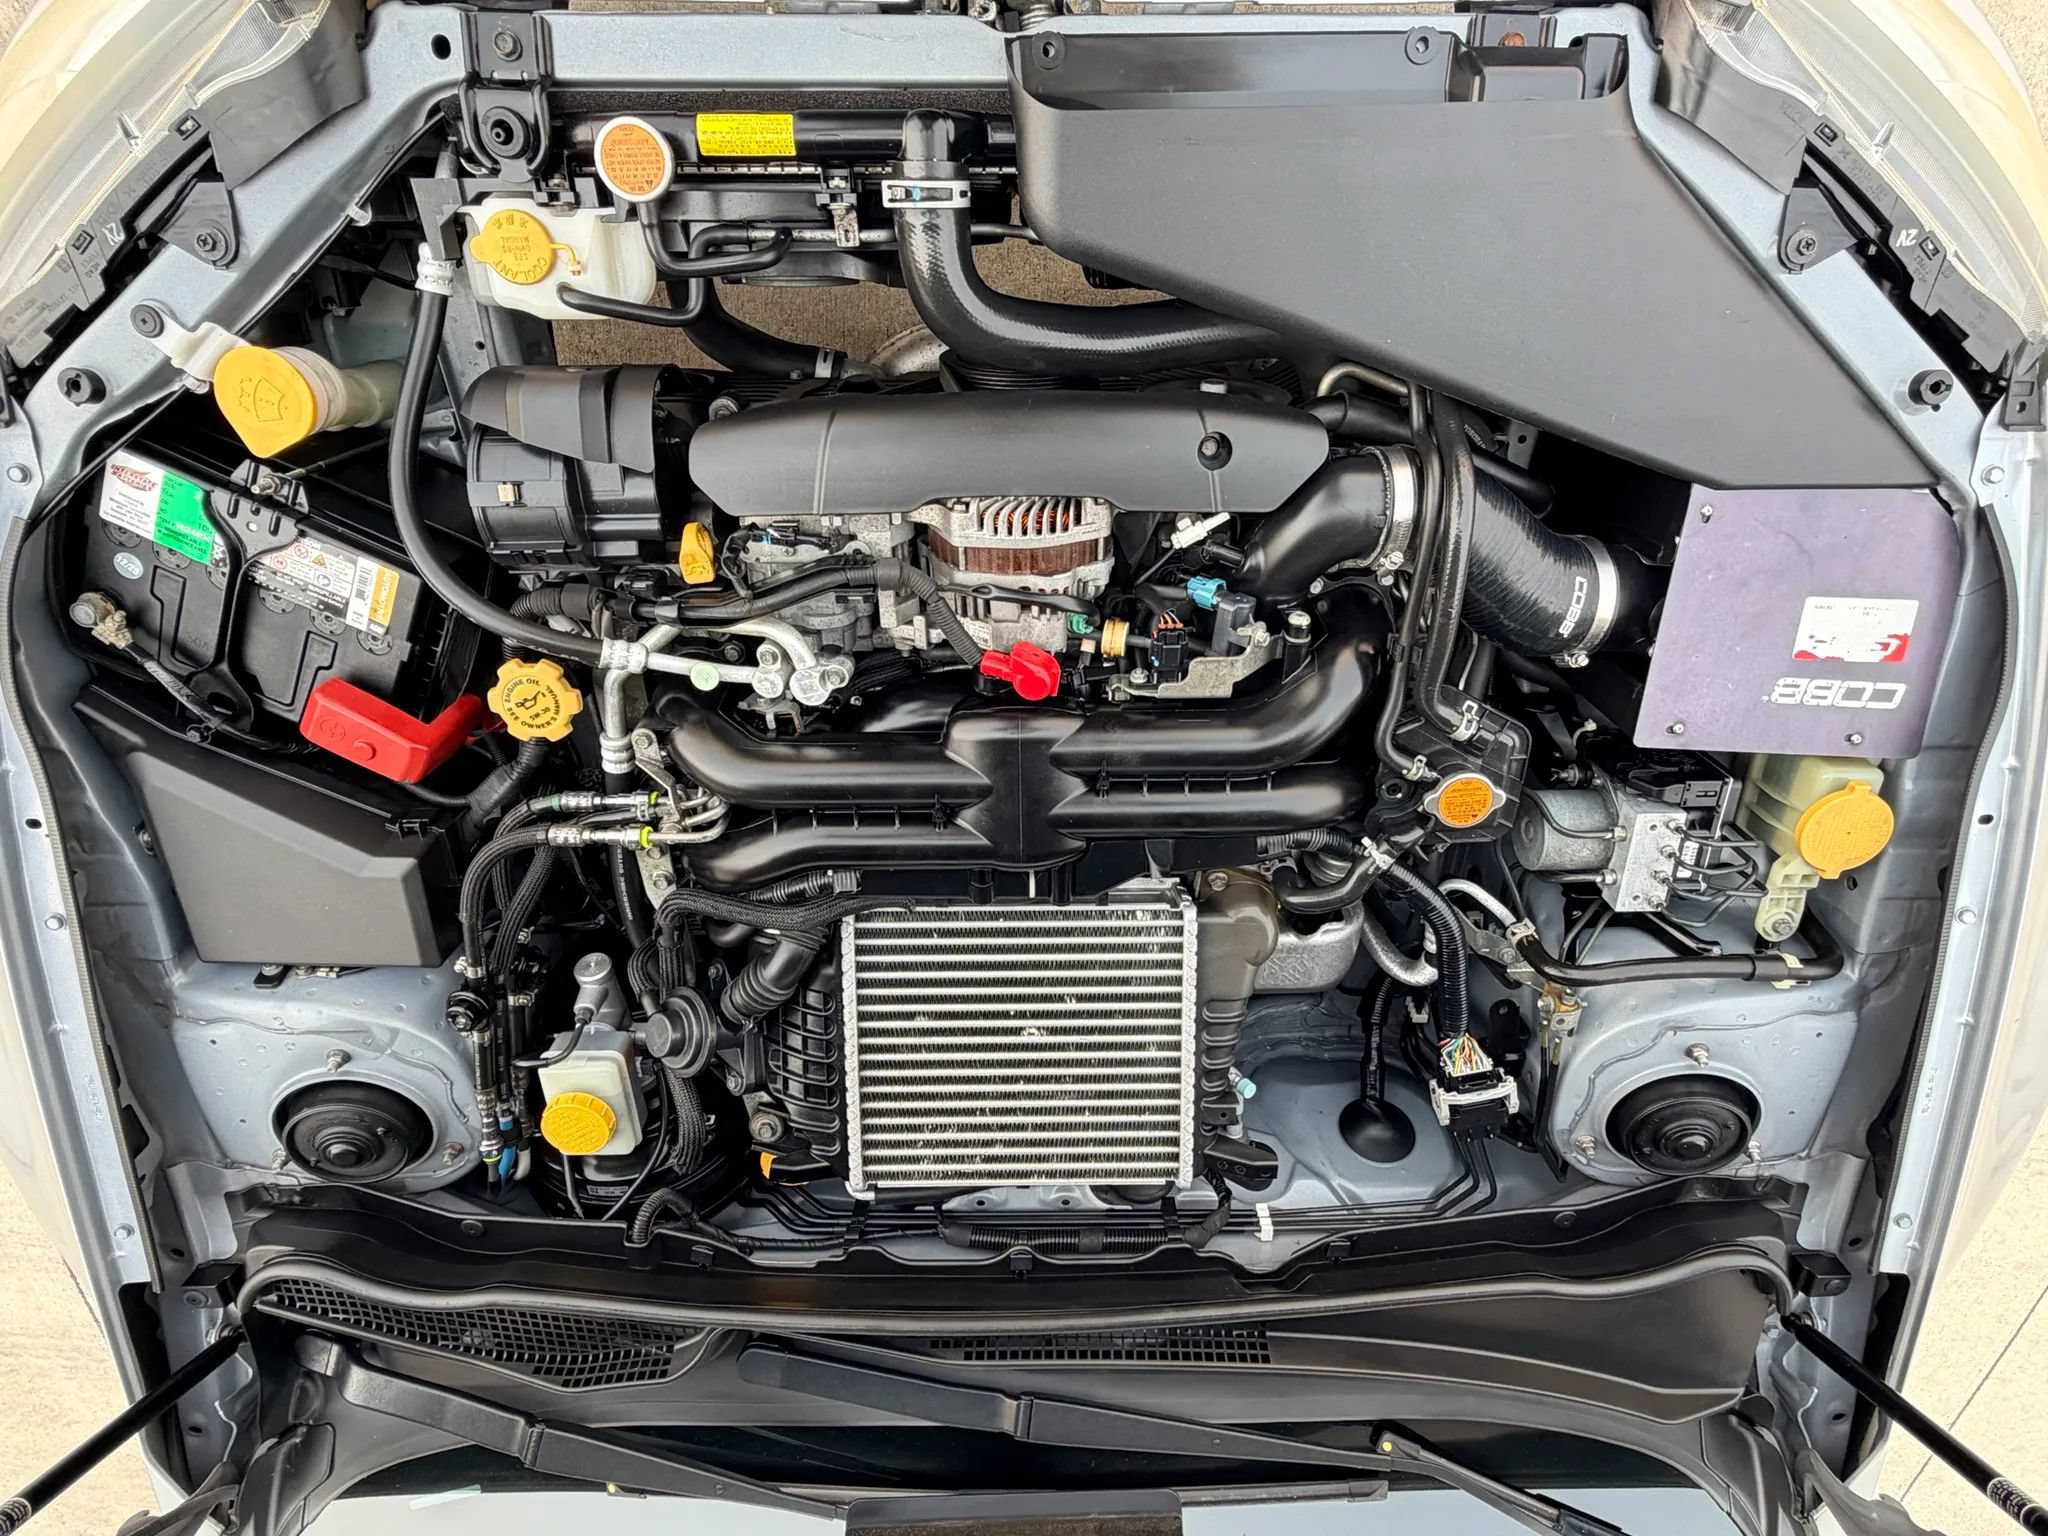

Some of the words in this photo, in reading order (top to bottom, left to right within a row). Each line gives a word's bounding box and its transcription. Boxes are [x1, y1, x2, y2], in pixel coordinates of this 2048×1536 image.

[494, 257, 548, 281] COOLANT
[111, 470, 153, 492] BATTERIES
[1559, 576, 1588, 636] COBB
[526, 678, 541, 687] OIL
[1769, 677, 1908, 709] COBB
[506, 707, 520, 721] SEE
[545, 685, 560, 716] MANUAL
